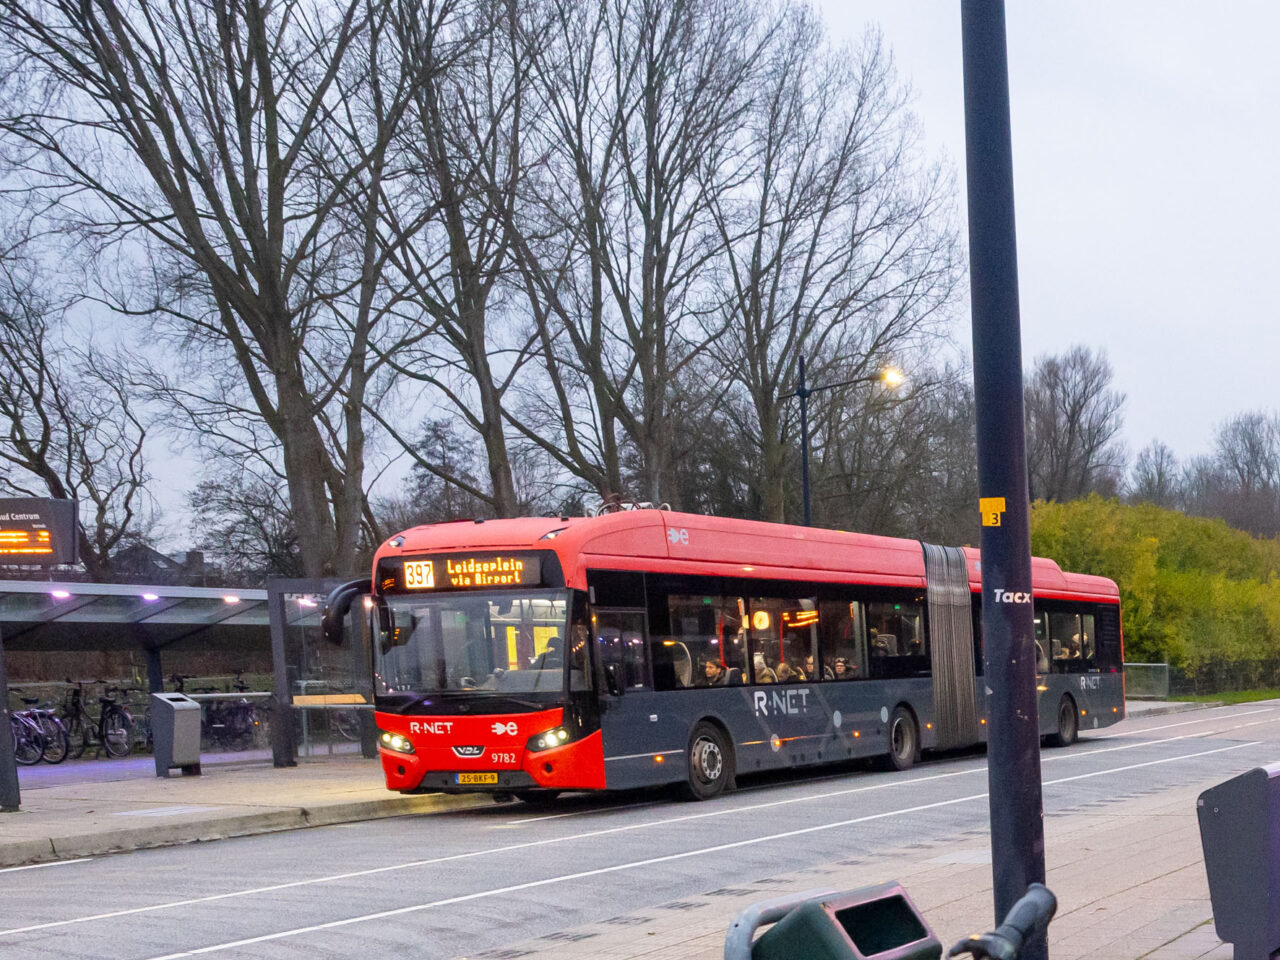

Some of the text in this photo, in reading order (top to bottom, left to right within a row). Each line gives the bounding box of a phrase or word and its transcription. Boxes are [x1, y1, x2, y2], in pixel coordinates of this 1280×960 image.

[447, 557, 523, 574] Leidseplein
[406, 564, 432, 585] 397
[451, 571, 521, 586] via Airport
[994, 589, 1031, 603] Tacx
[491, 753, 516, 763] 9782
